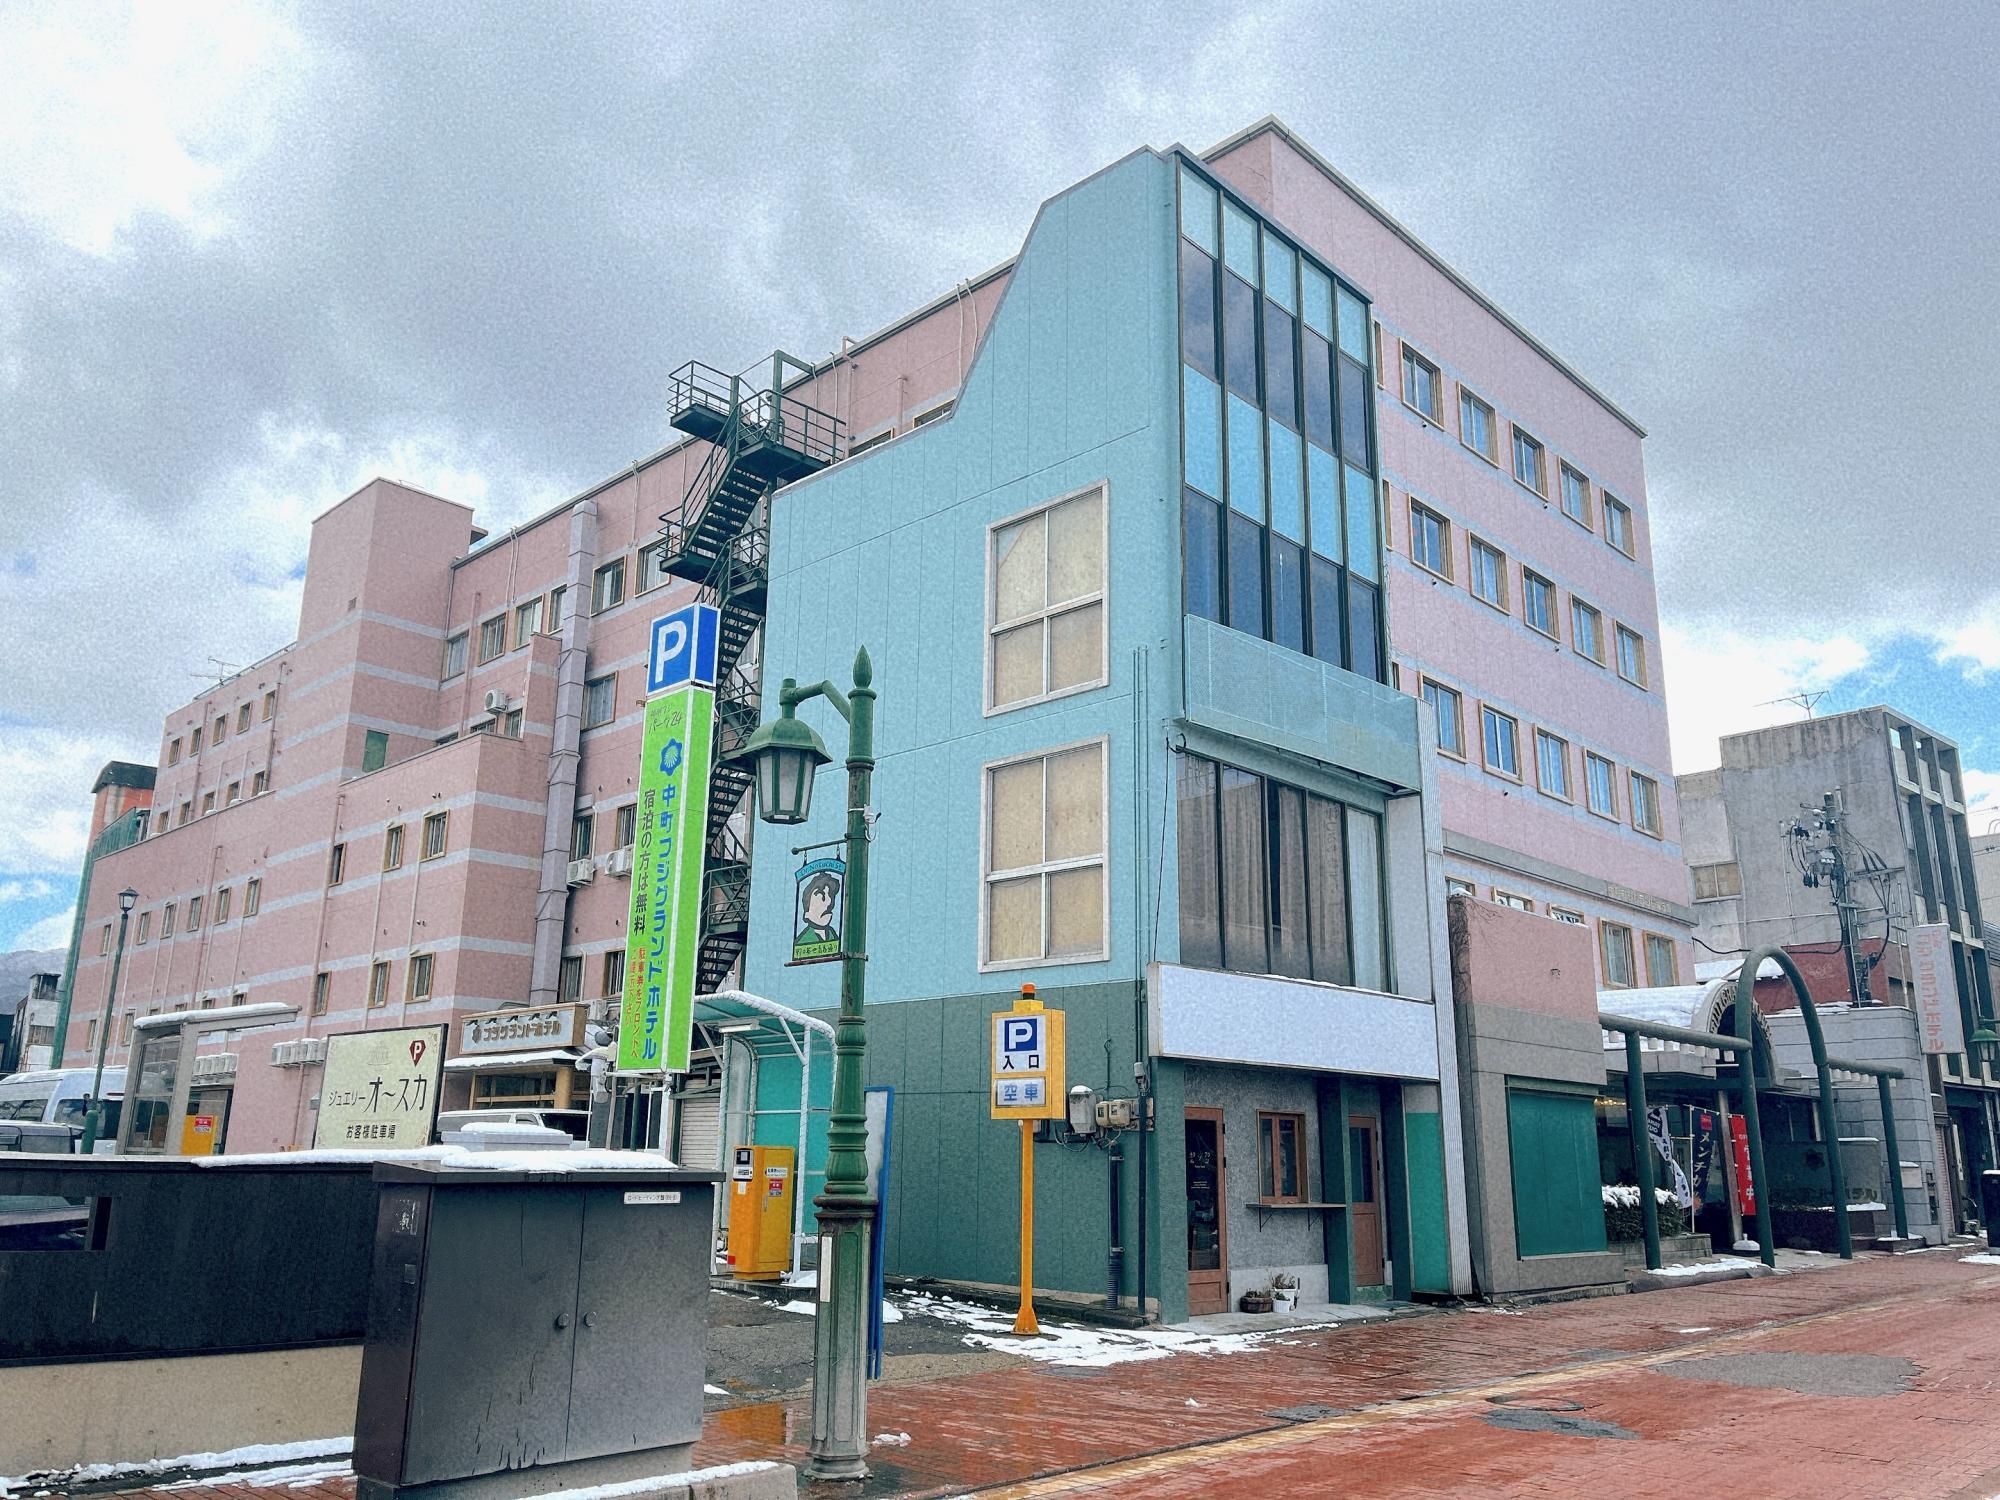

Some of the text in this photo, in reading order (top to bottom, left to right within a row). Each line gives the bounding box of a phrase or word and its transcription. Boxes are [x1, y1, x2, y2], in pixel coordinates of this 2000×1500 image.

[654, 619, 687, 684] P
[634, 788, 656, 936] 宿泊の方は無料
[642, 783, 677, 1060] 中町フジグランドホテル
[631, 947, 646, 1058] 駐車券をフロントへ
[1008, 1021, 1033, 1050] P
[413, 1041, 422, 1061] P
[1002, 1054, 1040, 1071] 入口
[328, 1090, 366, 1107] ジュエリー
[1003, 1082, 1039, 1102] 空車
[345, 1124, 397, 1140] お客様駐車場
